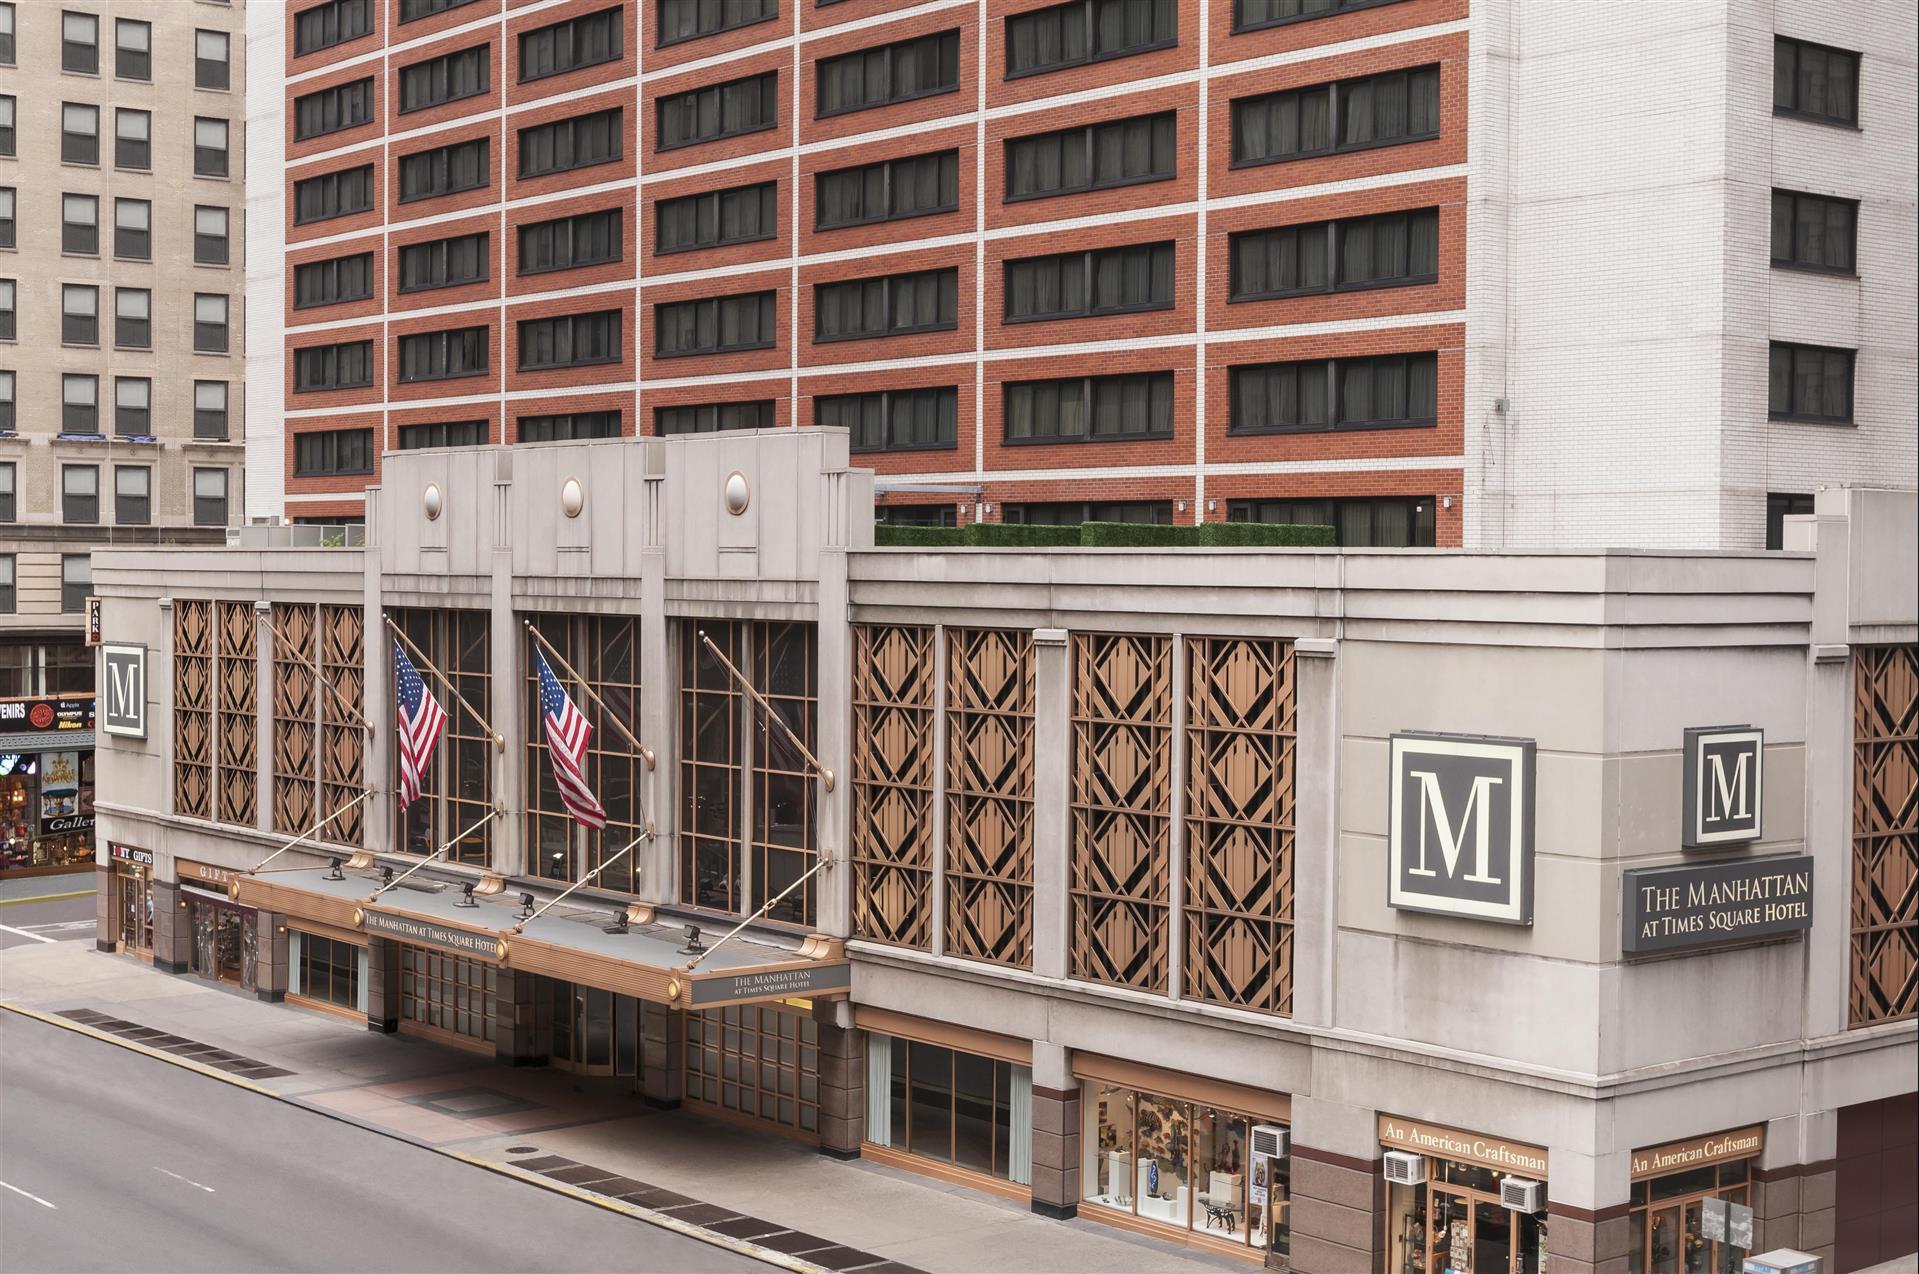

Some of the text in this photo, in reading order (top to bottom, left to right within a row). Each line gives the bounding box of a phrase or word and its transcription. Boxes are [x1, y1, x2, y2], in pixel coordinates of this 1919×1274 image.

[108, 662, 138, 718] M
[1706, 752, 1753, 821] M
[1409, 770, 1502, 884] M
[133, 850, 152, 864] GIFTS
[1642, 872, 1809, 912] THE MANHATTAN
[366, 913, 378, 926] THE
[379, 918, 418, 934] MANHATTAN
[419, 929, 427, 937] AT
[428, 927, 447, 941] TIMES
[448, 931, 473, 948] SQUARE
[1642, 902, 1808, 938] AT TIMES SQUARE HOTEL
[735, 971, 811, 987] THE MANHATTAN
[744, 986, 763, 994] TIMES
[764, 983, 787, 992] SQUARE
[1385, 1122, 1546, 1171] An American Craftsman
[1632, 1136, 1758, 1173] An American Craftsman
